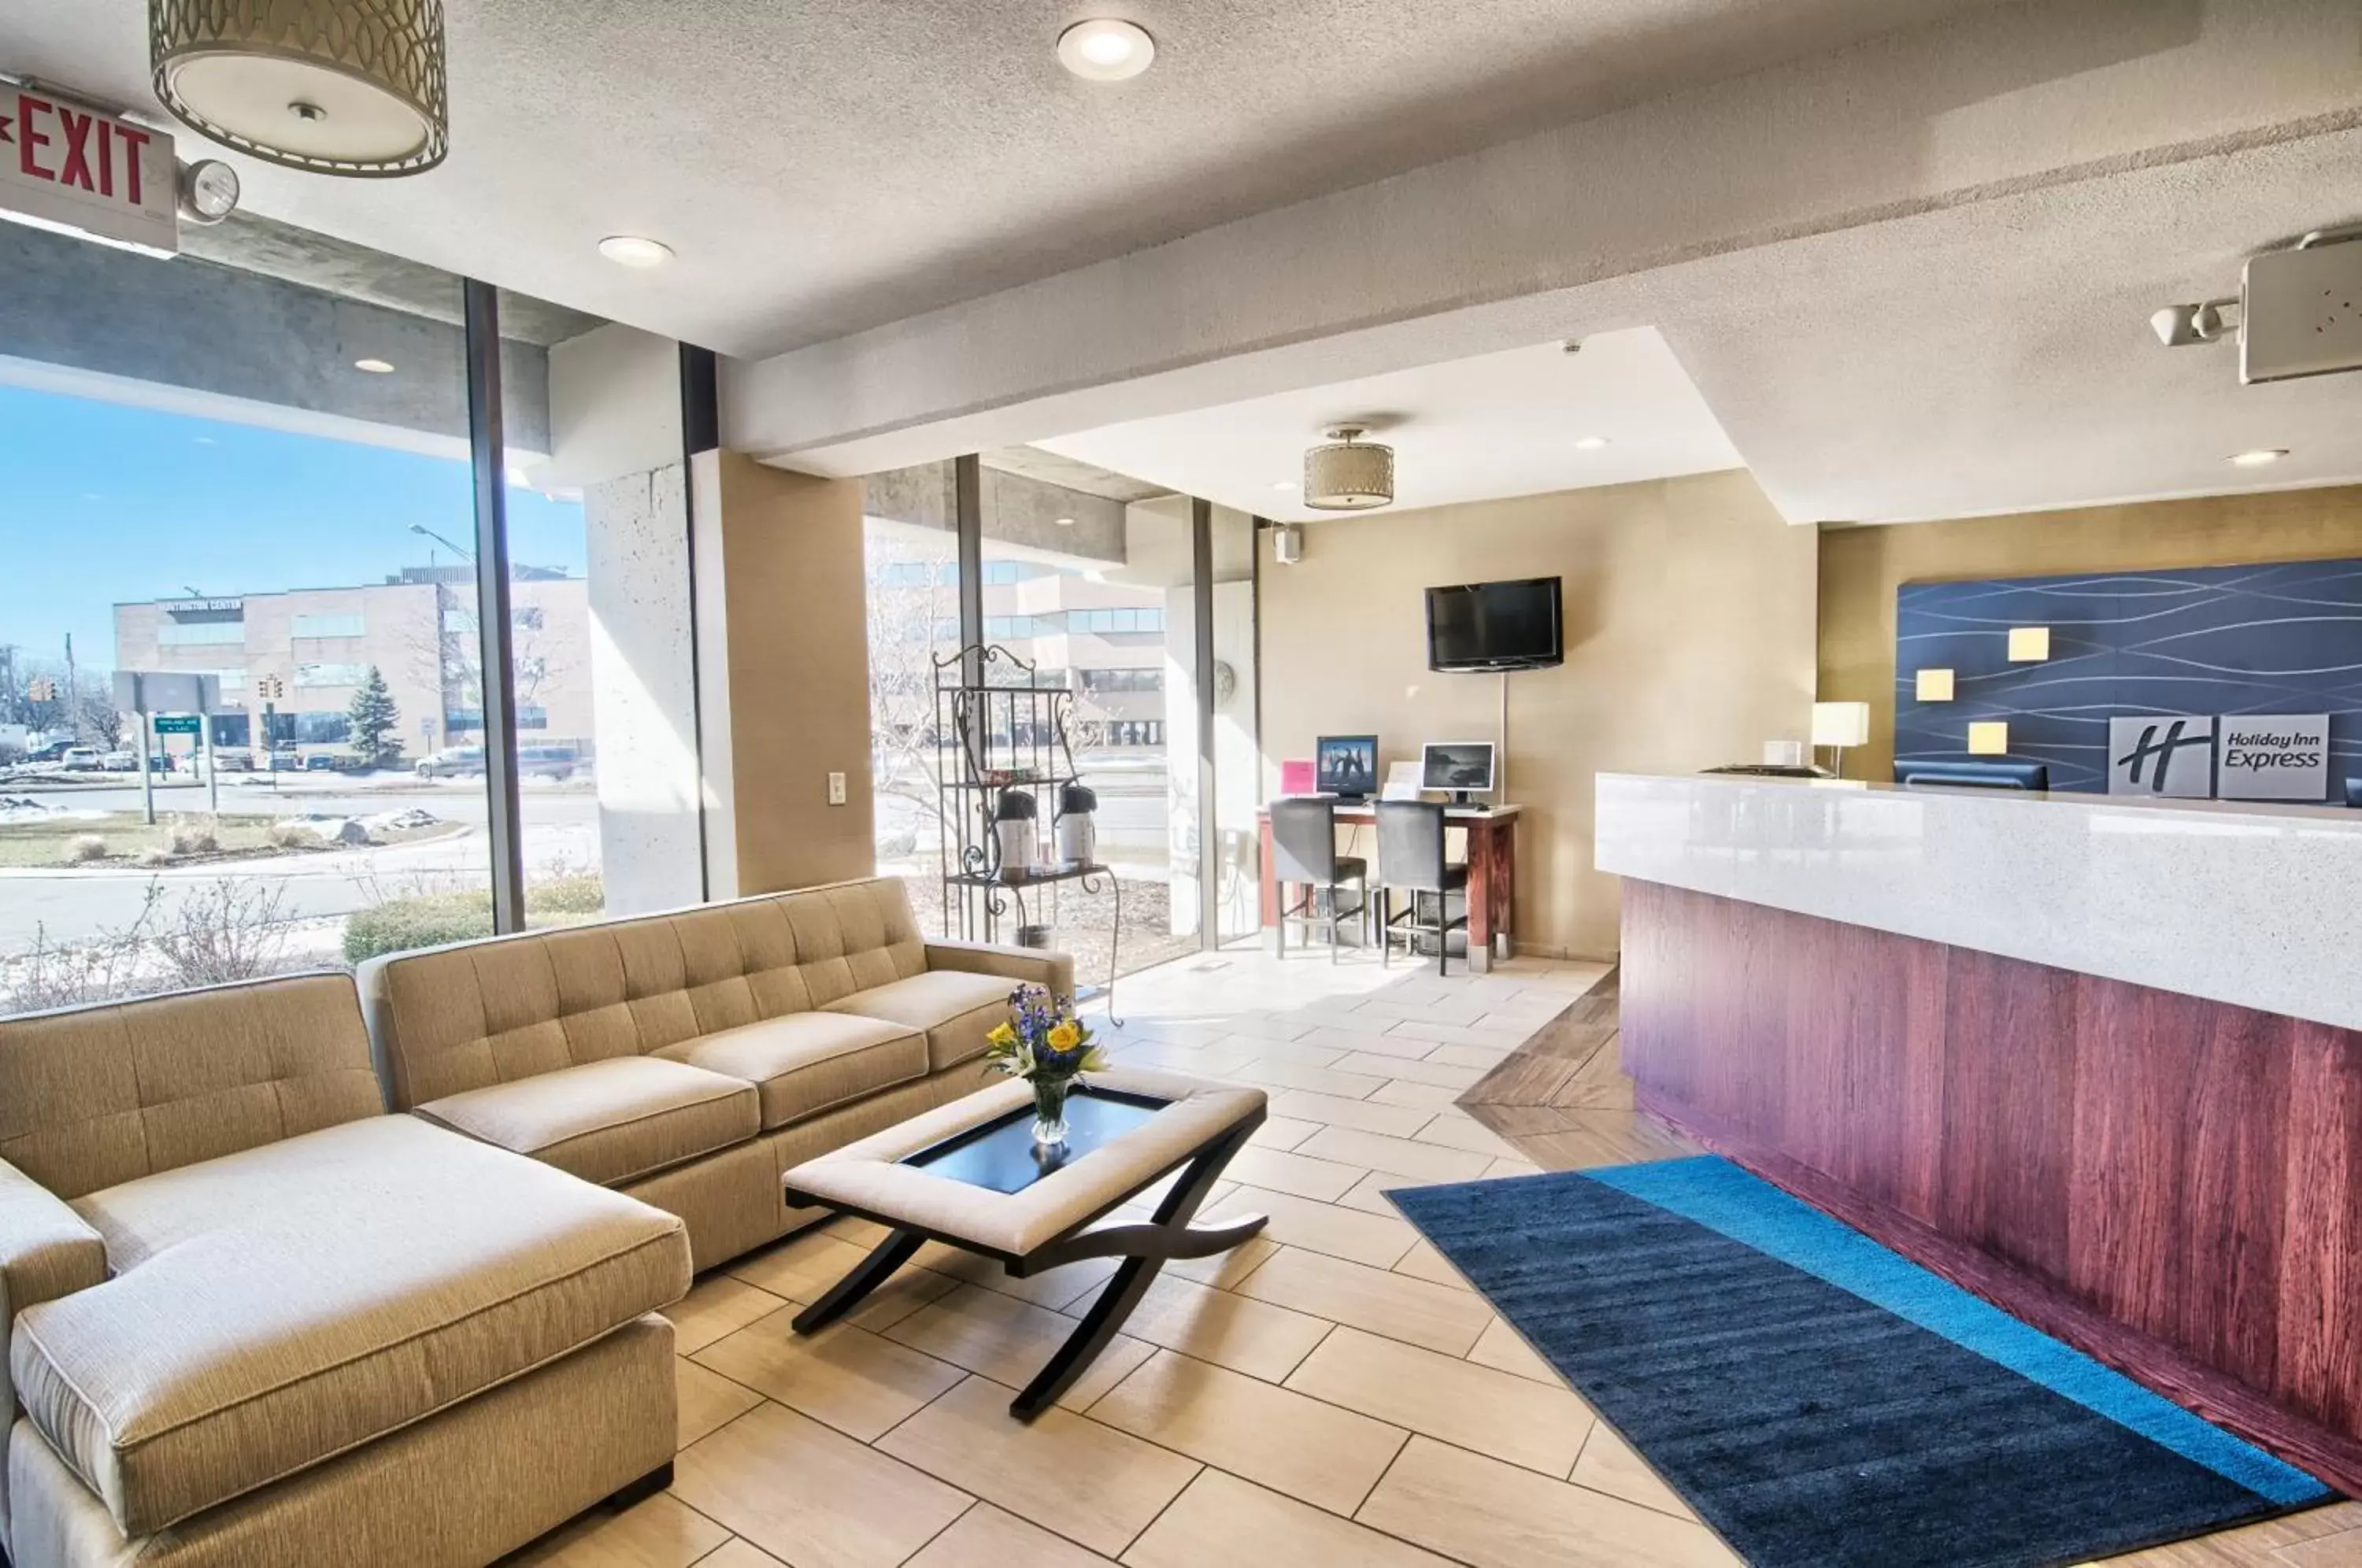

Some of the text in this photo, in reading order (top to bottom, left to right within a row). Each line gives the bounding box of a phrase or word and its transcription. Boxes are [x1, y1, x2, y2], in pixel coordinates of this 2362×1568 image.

[19, 94, 150, 205] EXIT
[2227, 732, 2321, 749] Holiday Inn
[2225, 749, 2321, 772] Express
